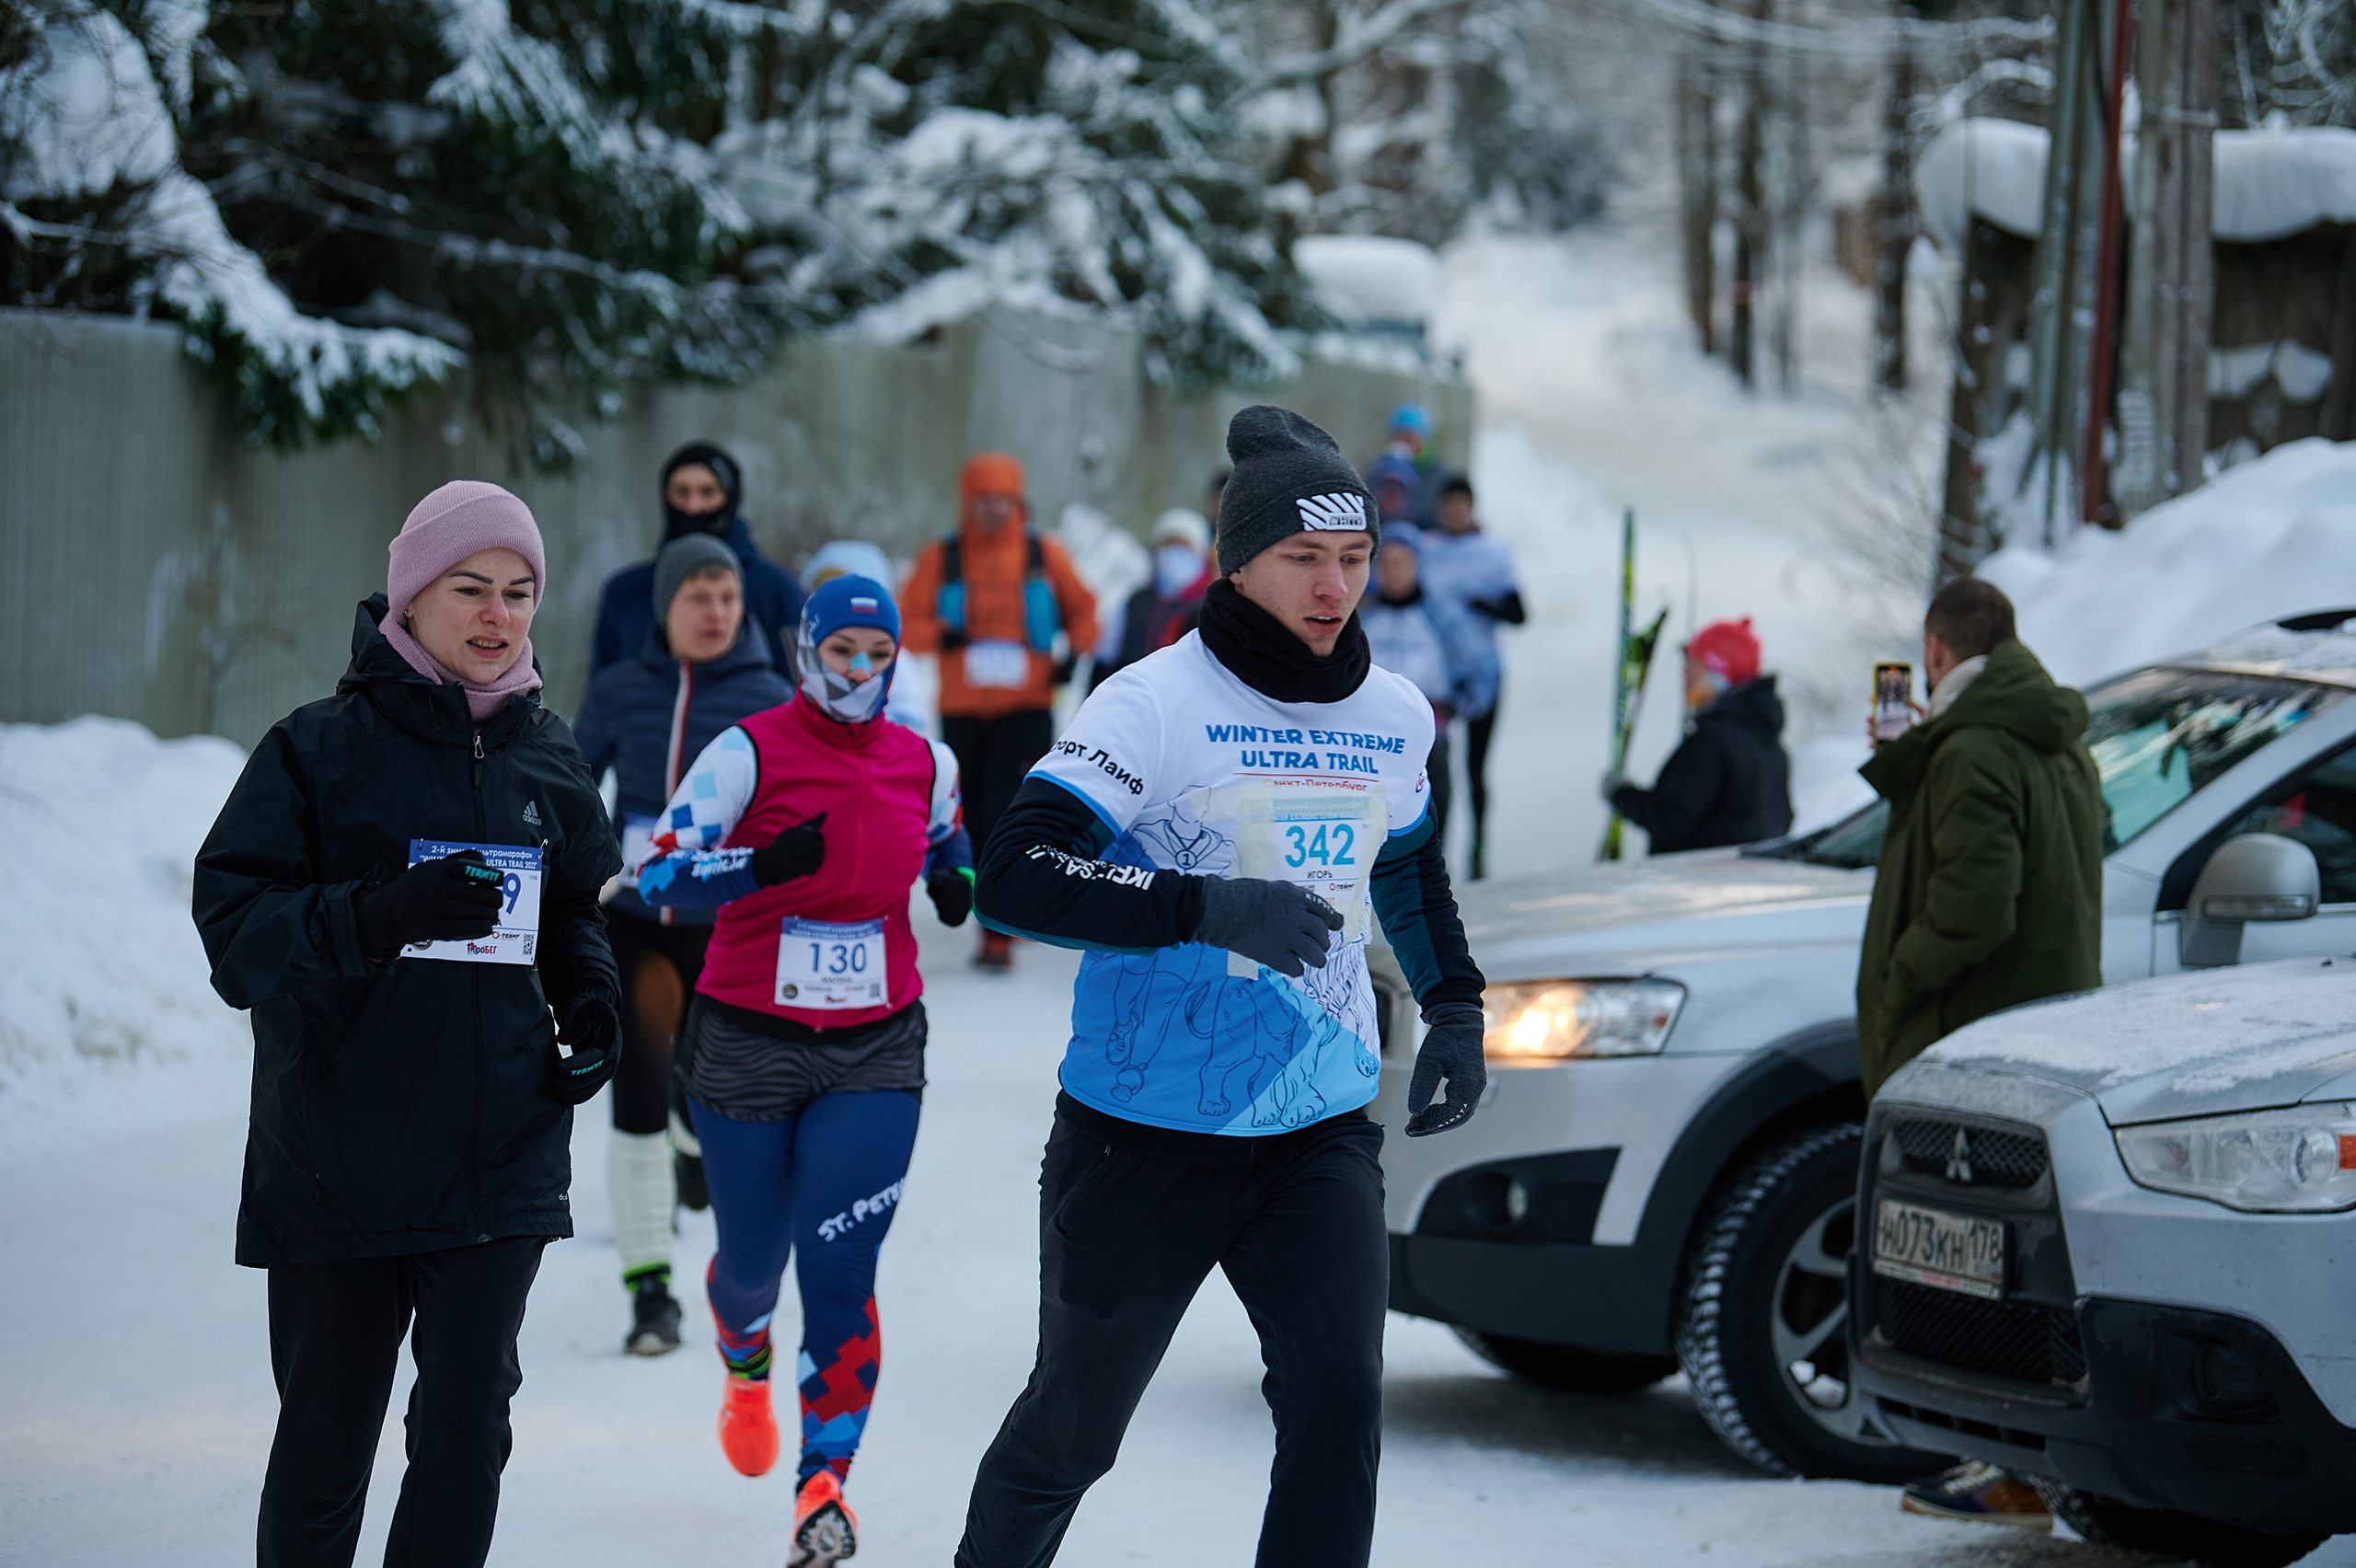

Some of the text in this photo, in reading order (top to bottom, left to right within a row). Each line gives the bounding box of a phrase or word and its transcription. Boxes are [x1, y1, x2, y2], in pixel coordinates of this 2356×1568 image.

[1206, 724, 1406, 755] WINTER EXTREME
[1241, 750, 1380, 775] ULTRA TRAIL
[1182, 853, 1190, 866] 1
[1285, 824, 1355, 868] 342
[486, 859, 506, 867] ULTRA
[508, 860, 524, 869] TRAIL
[1307, 870, 1333, 879] ИГОРЬ
[809, 942, 866, 974] 130
[817, 1211, 855, 1242] ST.
